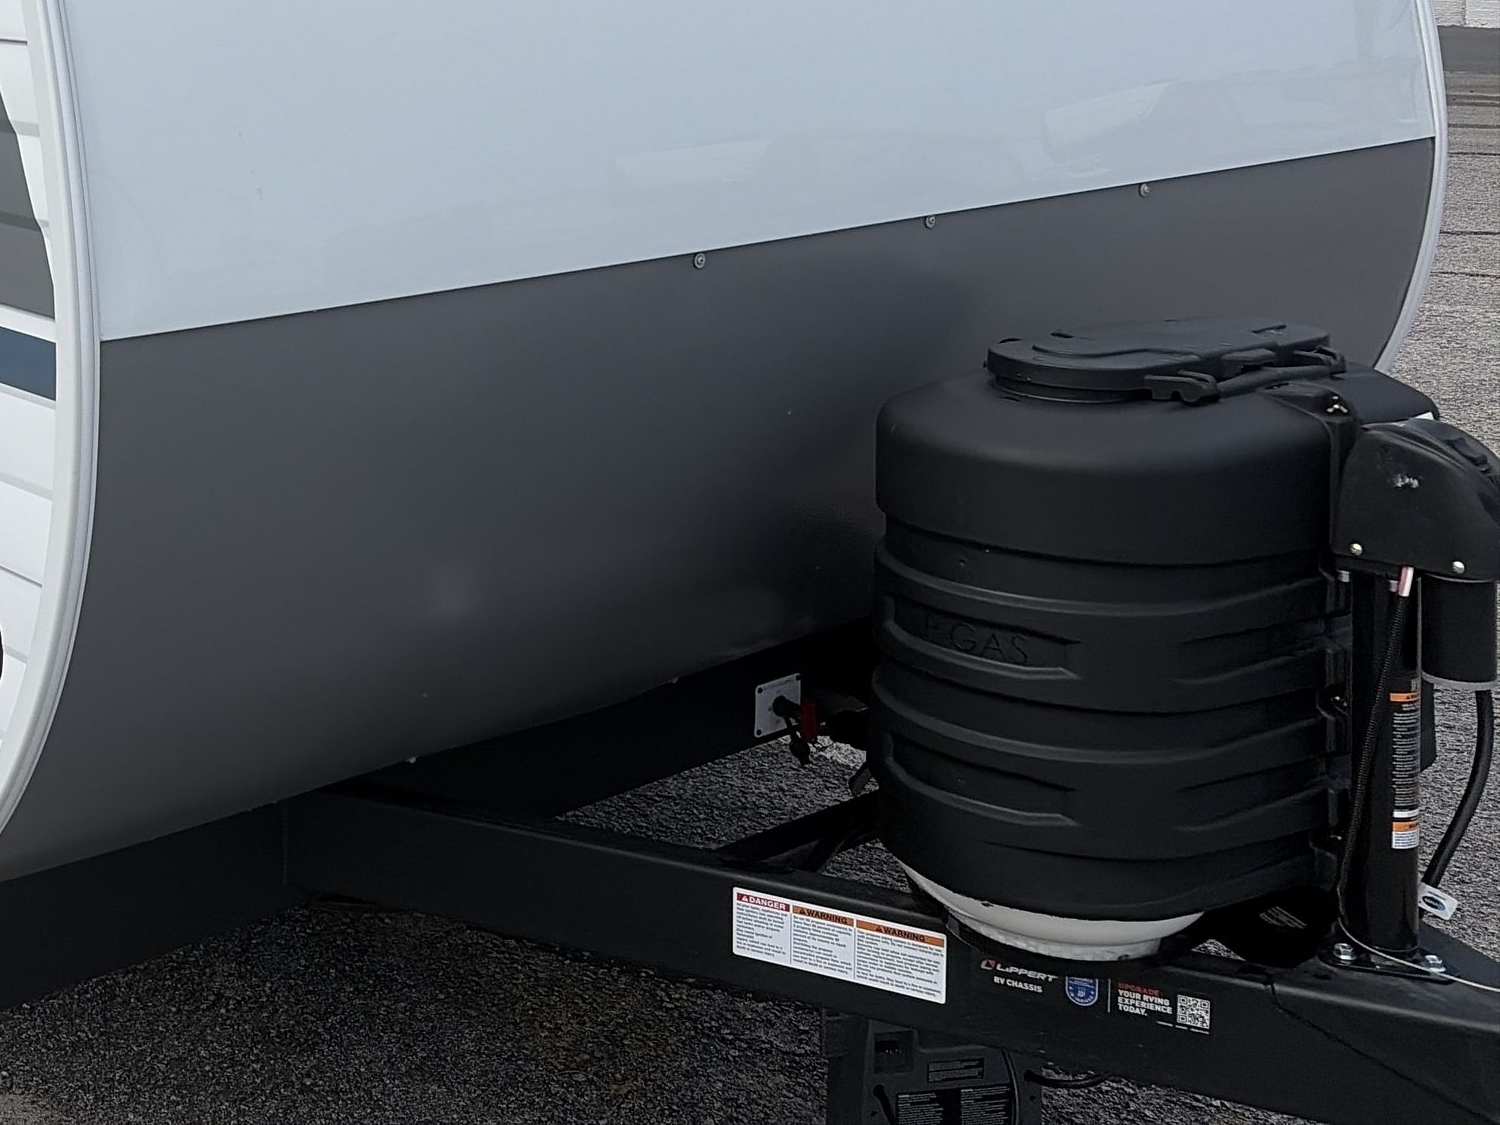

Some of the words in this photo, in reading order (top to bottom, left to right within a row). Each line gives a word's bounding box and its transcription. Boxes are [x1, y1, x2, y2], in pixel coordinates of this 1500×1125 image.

[952, 622, 1029, 664] GAS
[748, 895, 786, 910] DANGER
[806, 909, 847, 924] WARNING
[883, 926, 925, 942] WARNING
[993, 976, 1005, 985] RV
[1006, 978, 1043, 993] CHASSIS
[1117, 982, 1160, 996] UPGRADE
[1118, 989, 1141, 1000] YOUR
[1143, 994, 1170, 1006] RVING
[1118, 996, 1173, 1015] EXPERIENCE
[1118, 1003, 1148, 1017] TODAY.
